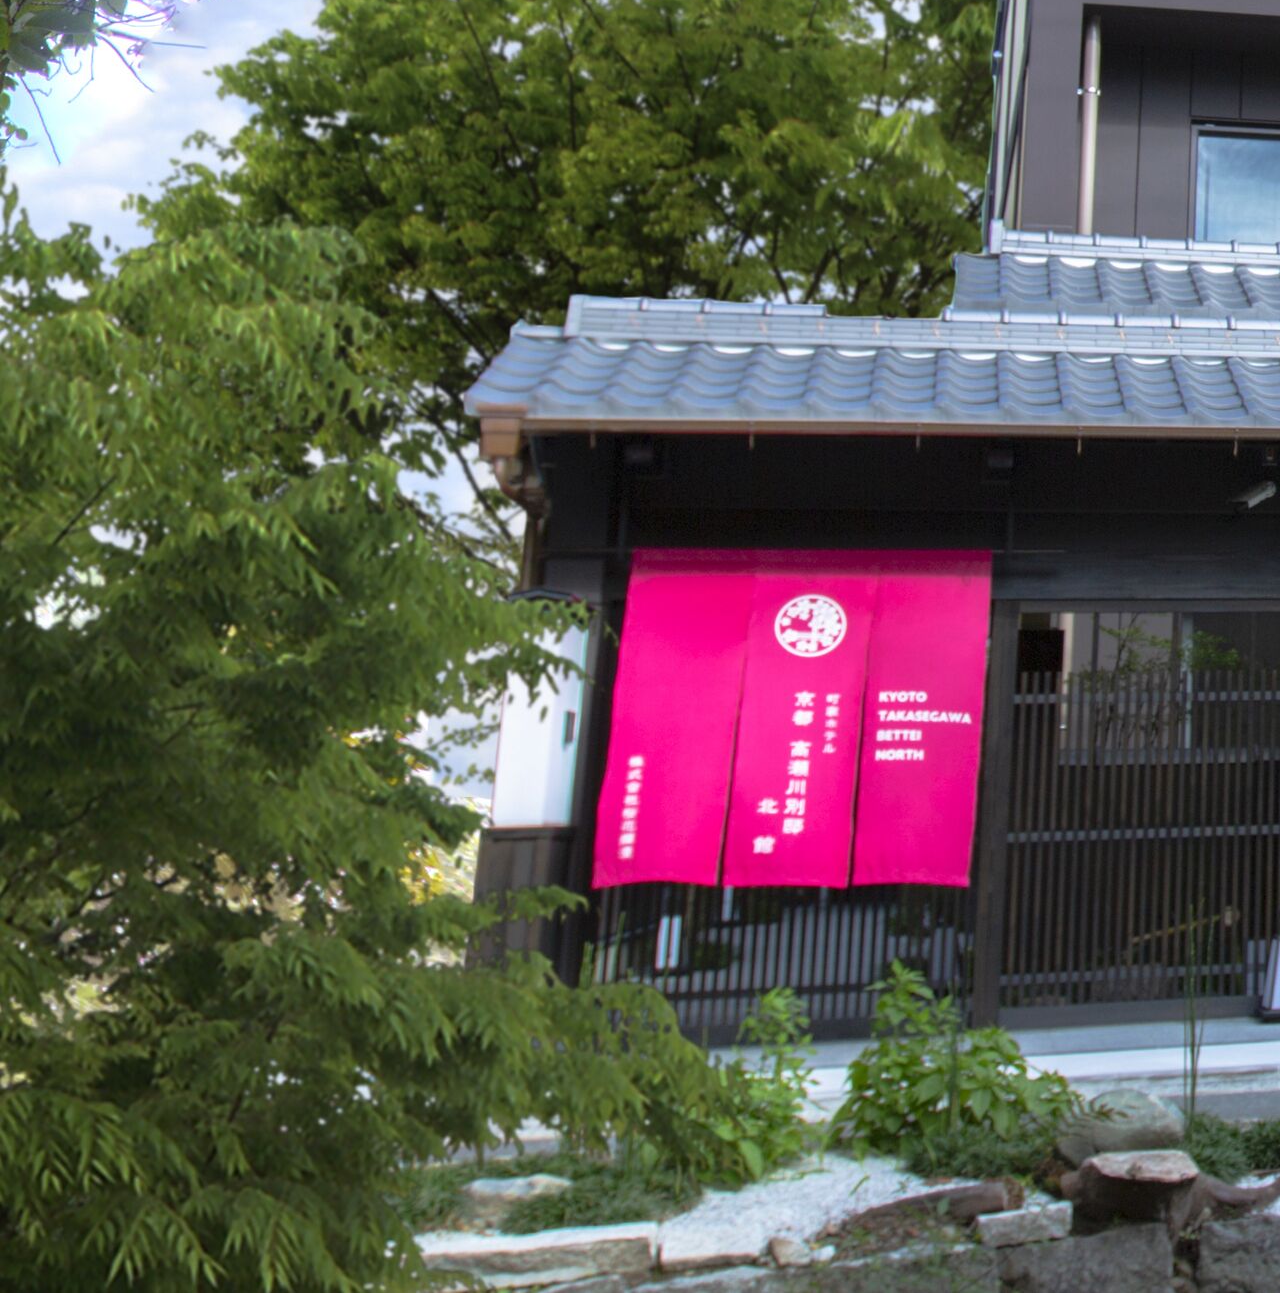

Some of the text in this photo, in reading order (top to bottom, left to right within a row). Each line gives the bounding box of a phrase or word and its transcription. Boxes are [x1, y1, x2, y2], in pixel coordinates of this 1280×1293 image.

[879, 691, 928, 703] KYOTO
[792, 691, 816, 726] 京都
[878, 710, 972, 724] TAKASEGAWA
[876, 729, 922, 742] BETTEI
[875, 749, 925, 761] NORTH
